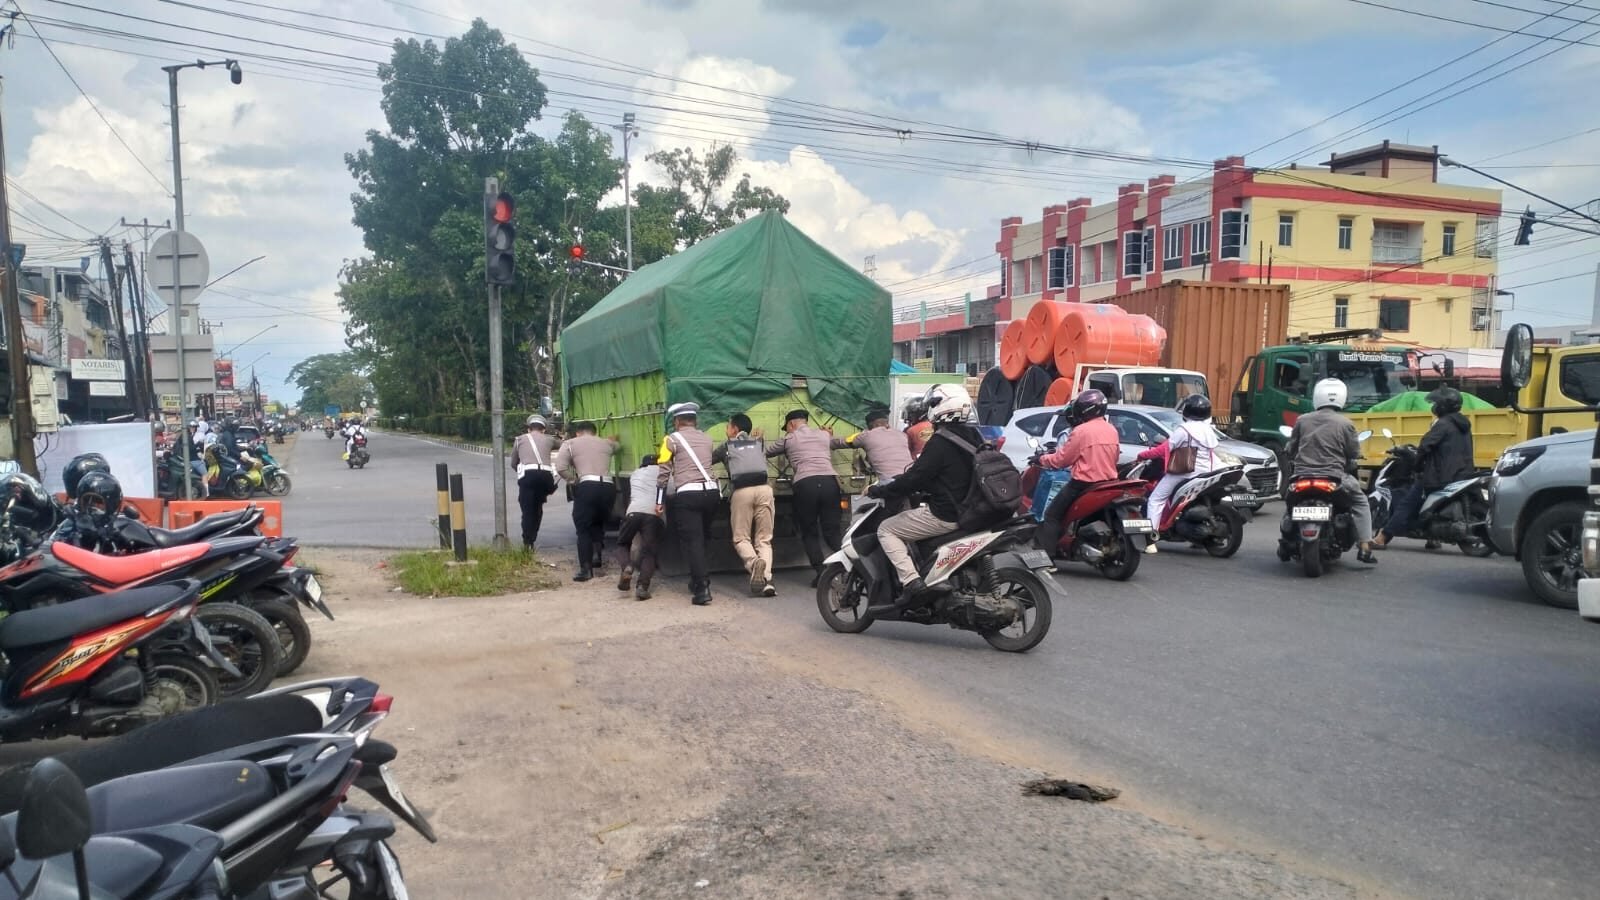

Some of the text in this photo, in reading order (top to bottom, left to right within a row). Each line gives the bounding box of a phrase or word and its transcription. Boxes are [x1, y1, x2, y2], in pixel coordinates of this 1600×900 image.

[1339, 351, 1403, 364] Budi Trans Cargo
[81, 361, 115, 369] NOTARIS
